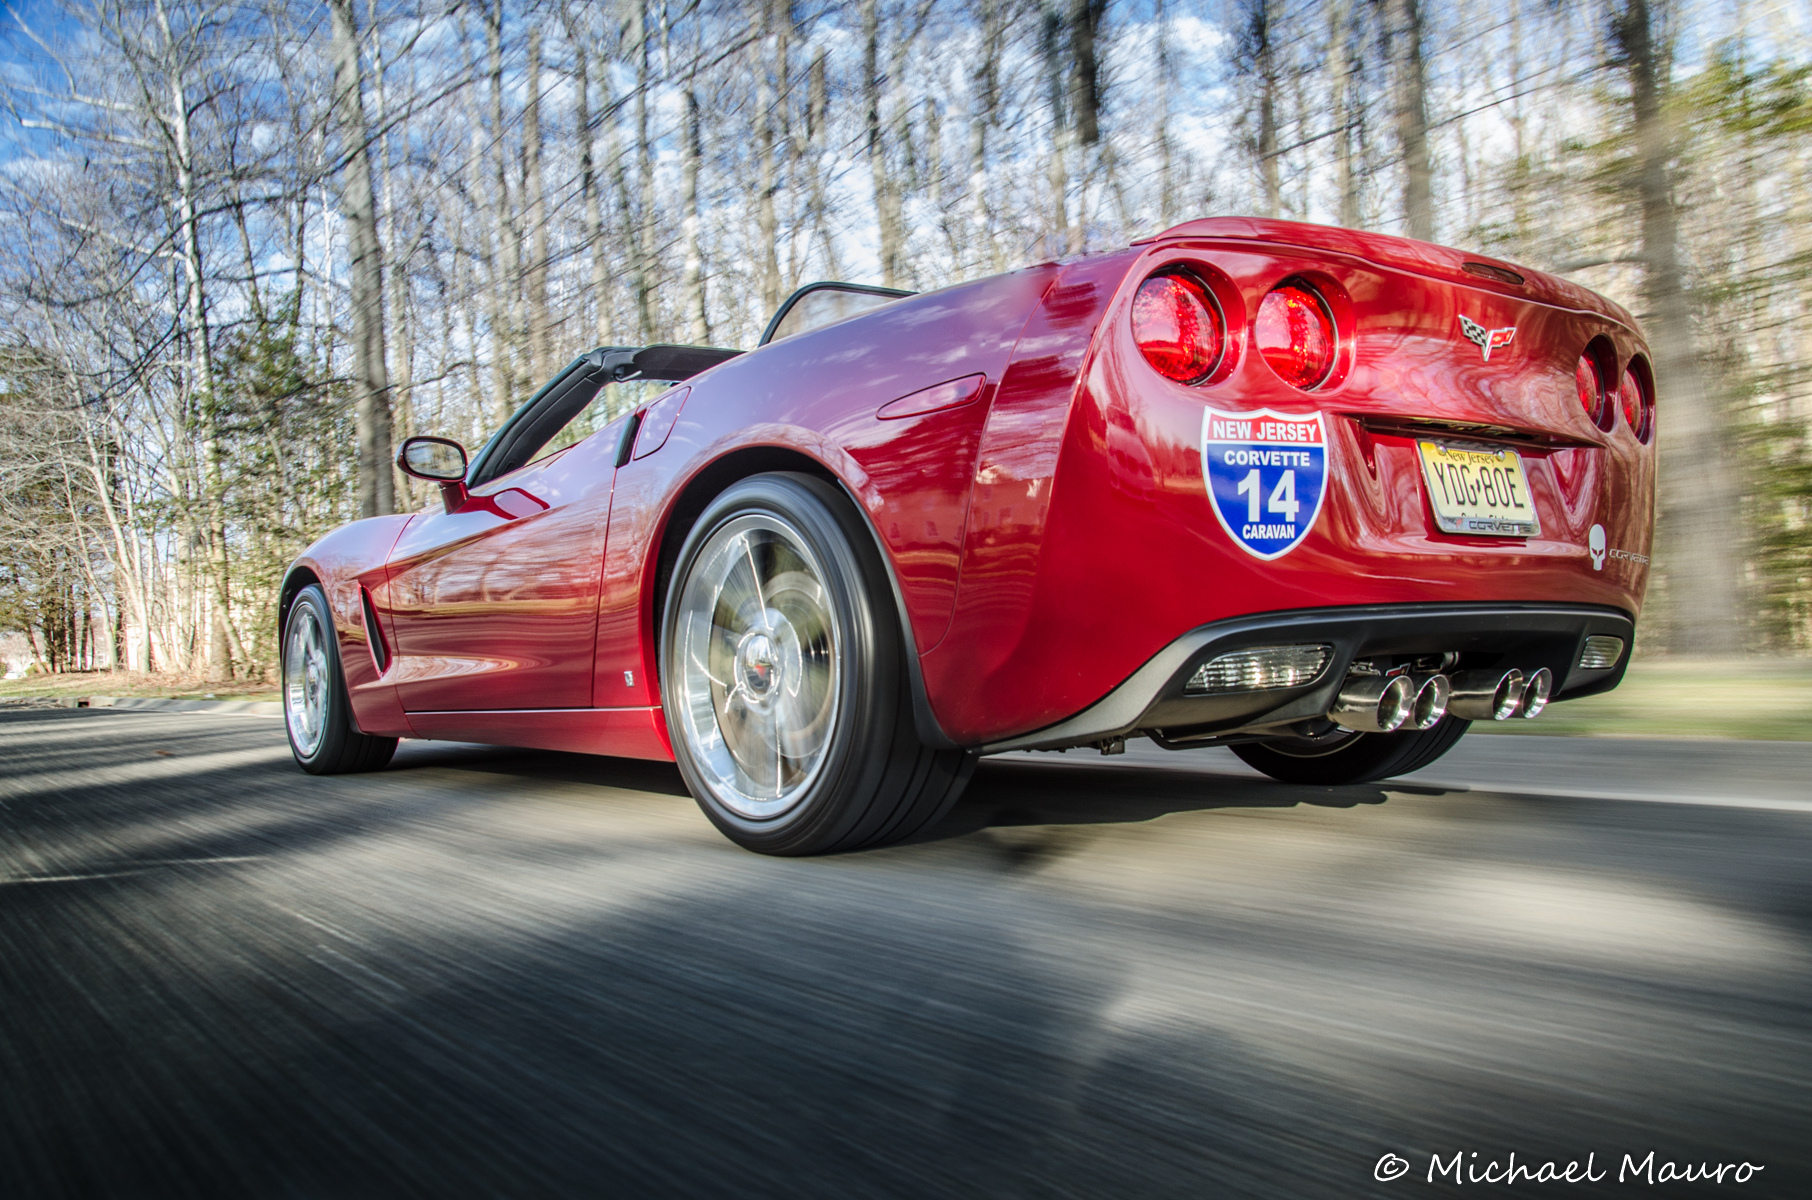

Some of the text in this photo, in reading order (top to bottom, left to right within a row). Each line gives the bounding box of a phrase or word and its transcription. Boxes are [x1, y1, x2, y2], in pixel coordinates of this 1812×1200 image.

[1212, 420, 1317, 442] NEW JERSEY
[1224, 450, 1311, 467] CORVETTE
[1446, 450, 1495, 467] New Jersey
[1237, 469, 1300, 522] 14
[1242, 524, 1295, 540] CARAVAN
